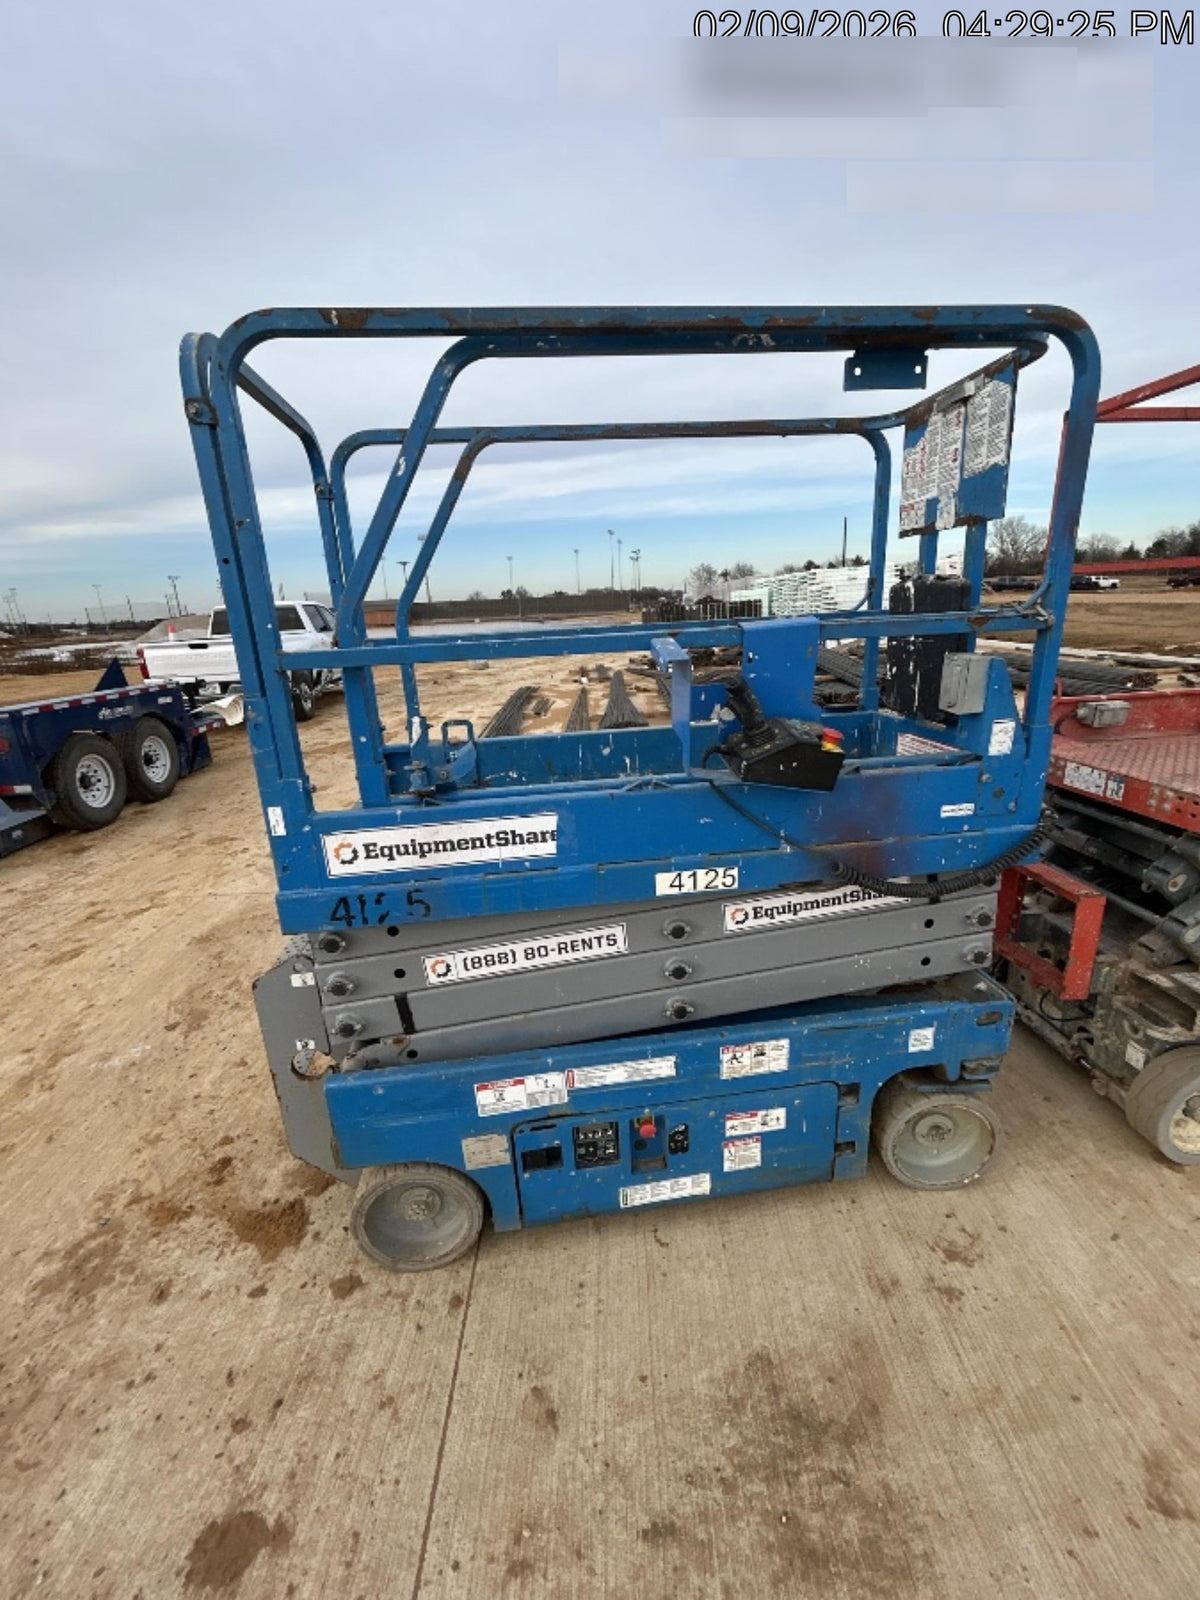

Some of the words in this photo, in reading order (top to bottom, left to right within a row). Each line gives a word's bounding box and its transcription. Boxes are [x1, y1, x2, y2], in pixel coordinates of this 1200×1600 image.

[669, 867, 737, 892] 4125
[463, 949, 517, 971] (888)
[524, 933, 618, 961] 80-RENTS
